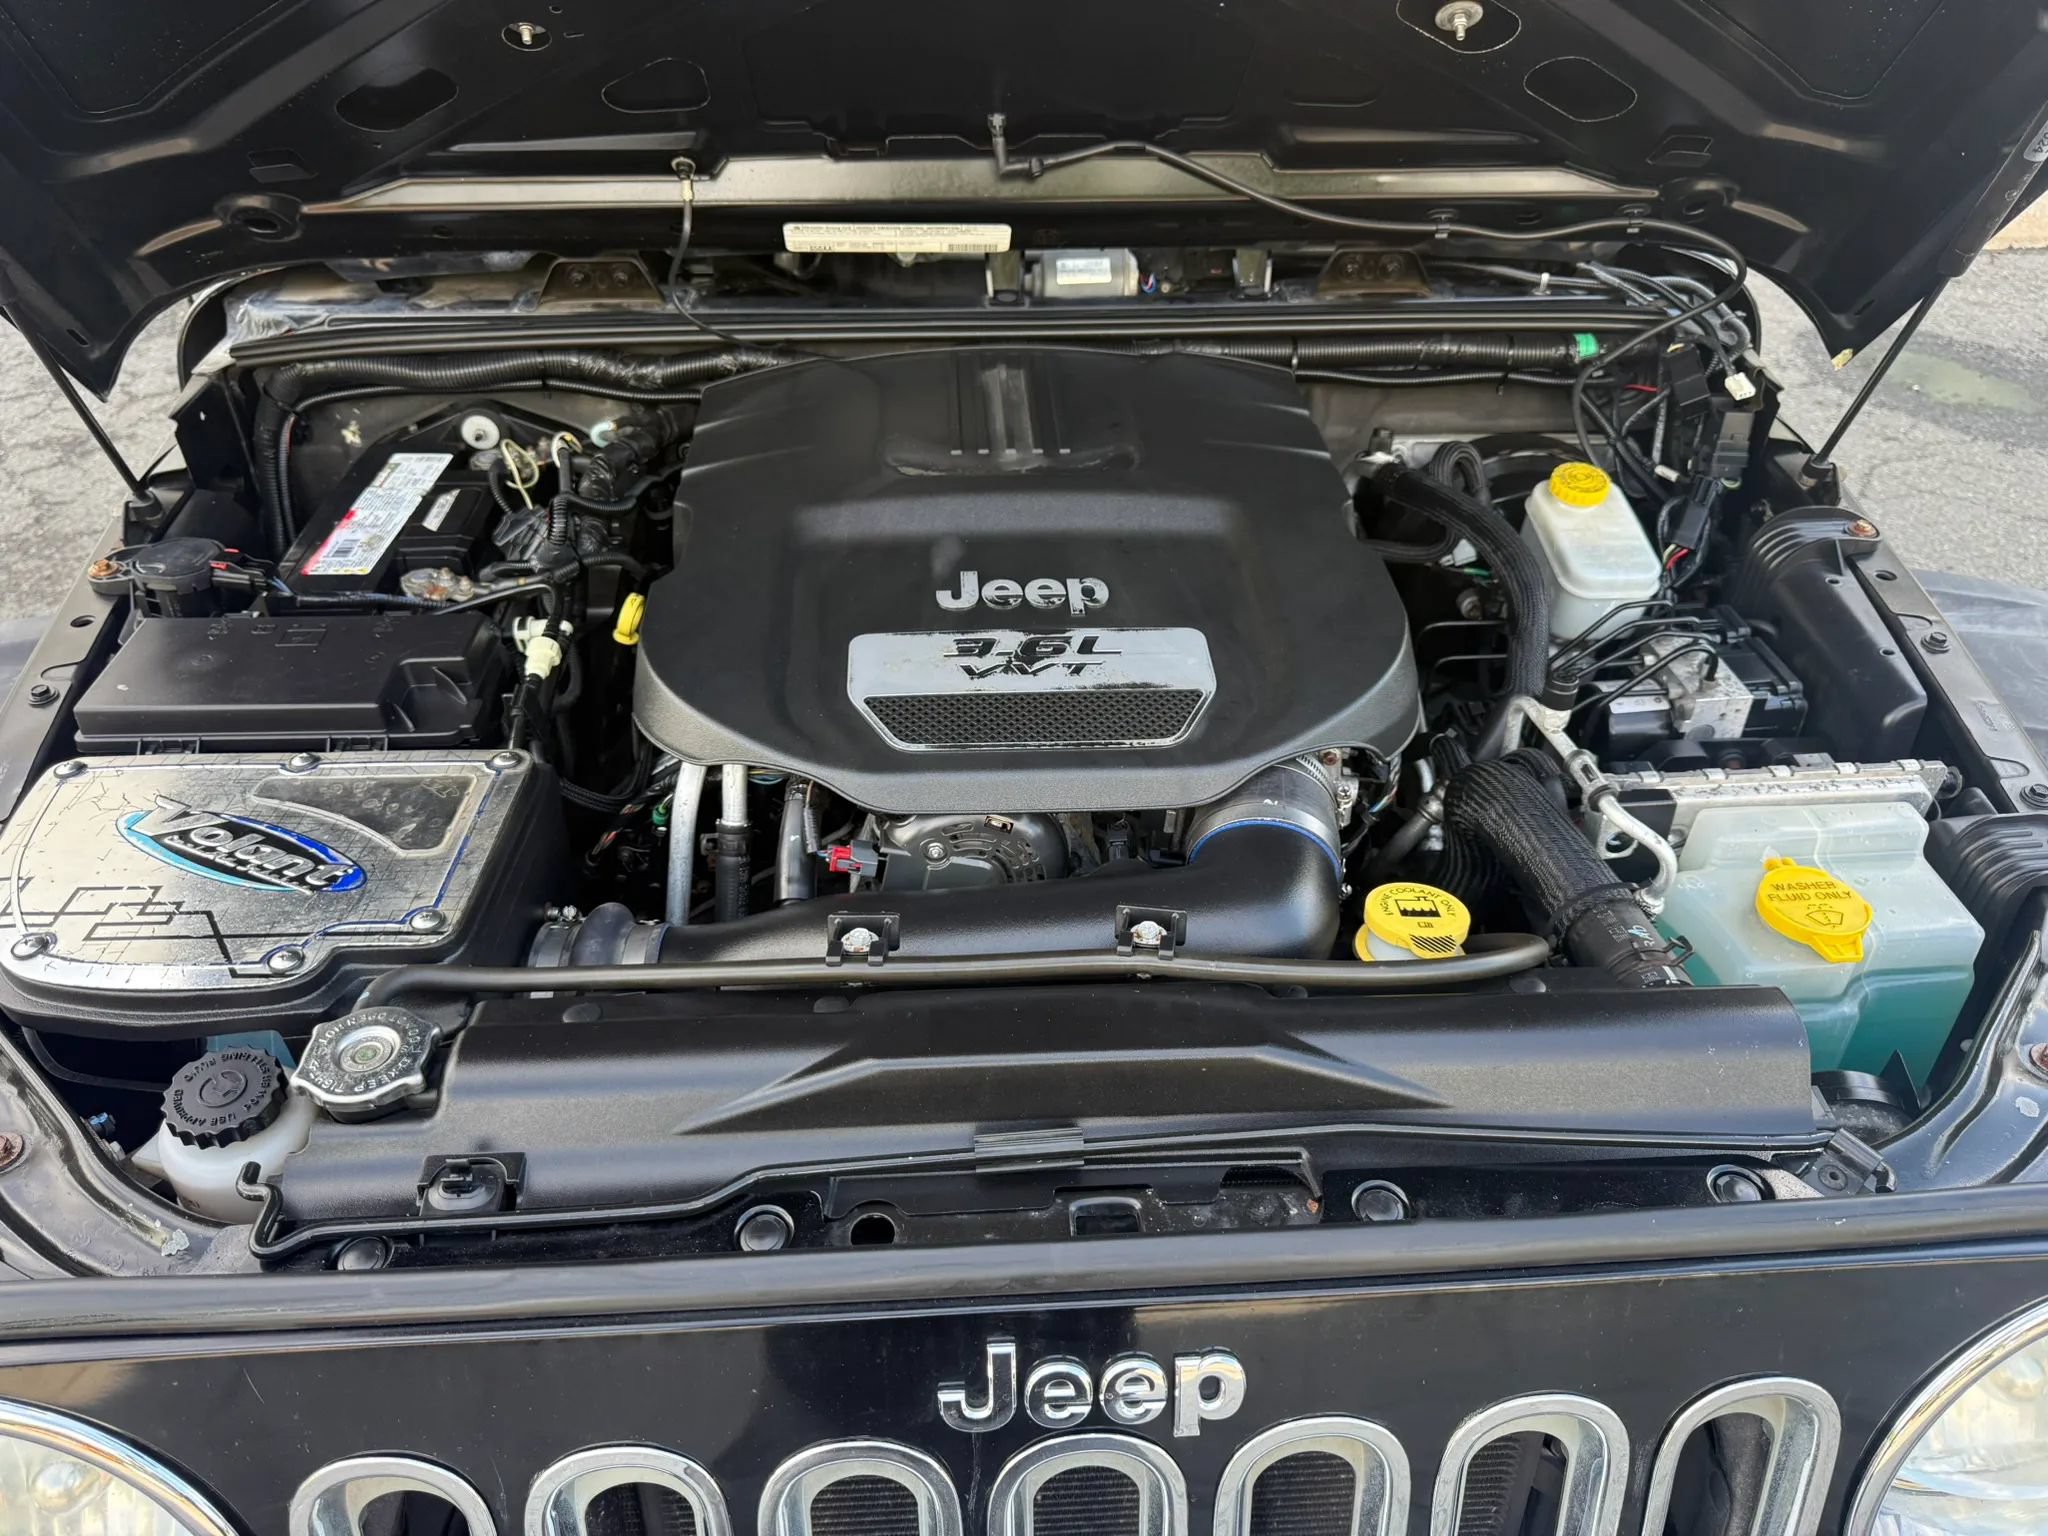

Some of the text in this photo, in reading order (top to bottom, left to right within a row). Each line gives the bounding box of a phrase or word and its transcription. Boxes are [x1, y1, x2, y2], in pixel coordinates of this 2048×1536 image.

[936, 571, 1109, 616] Jeep
[944, 636, 1122, 657] 3.6L
[959, 660, 1107, 678] VVT
[126, 795, 353, 885] Volant
[1767, 890, 1852, 902] FLUID ONLY
[1770, 881, 1837, 891] WASHER
[1389, 887, 1442, 899] COOLANT
[1440, 899, 1457, 917] ONLY
[319, 1023, 345, 1045] HOT
[221, 1051, 271, 1076] STEERING
[309, 1068, 398, 1093] KEEP TIGHT
[173, 1088, 237, 1127] USE APPROVED
[937, 1336, 1247, 1437] Jeep
